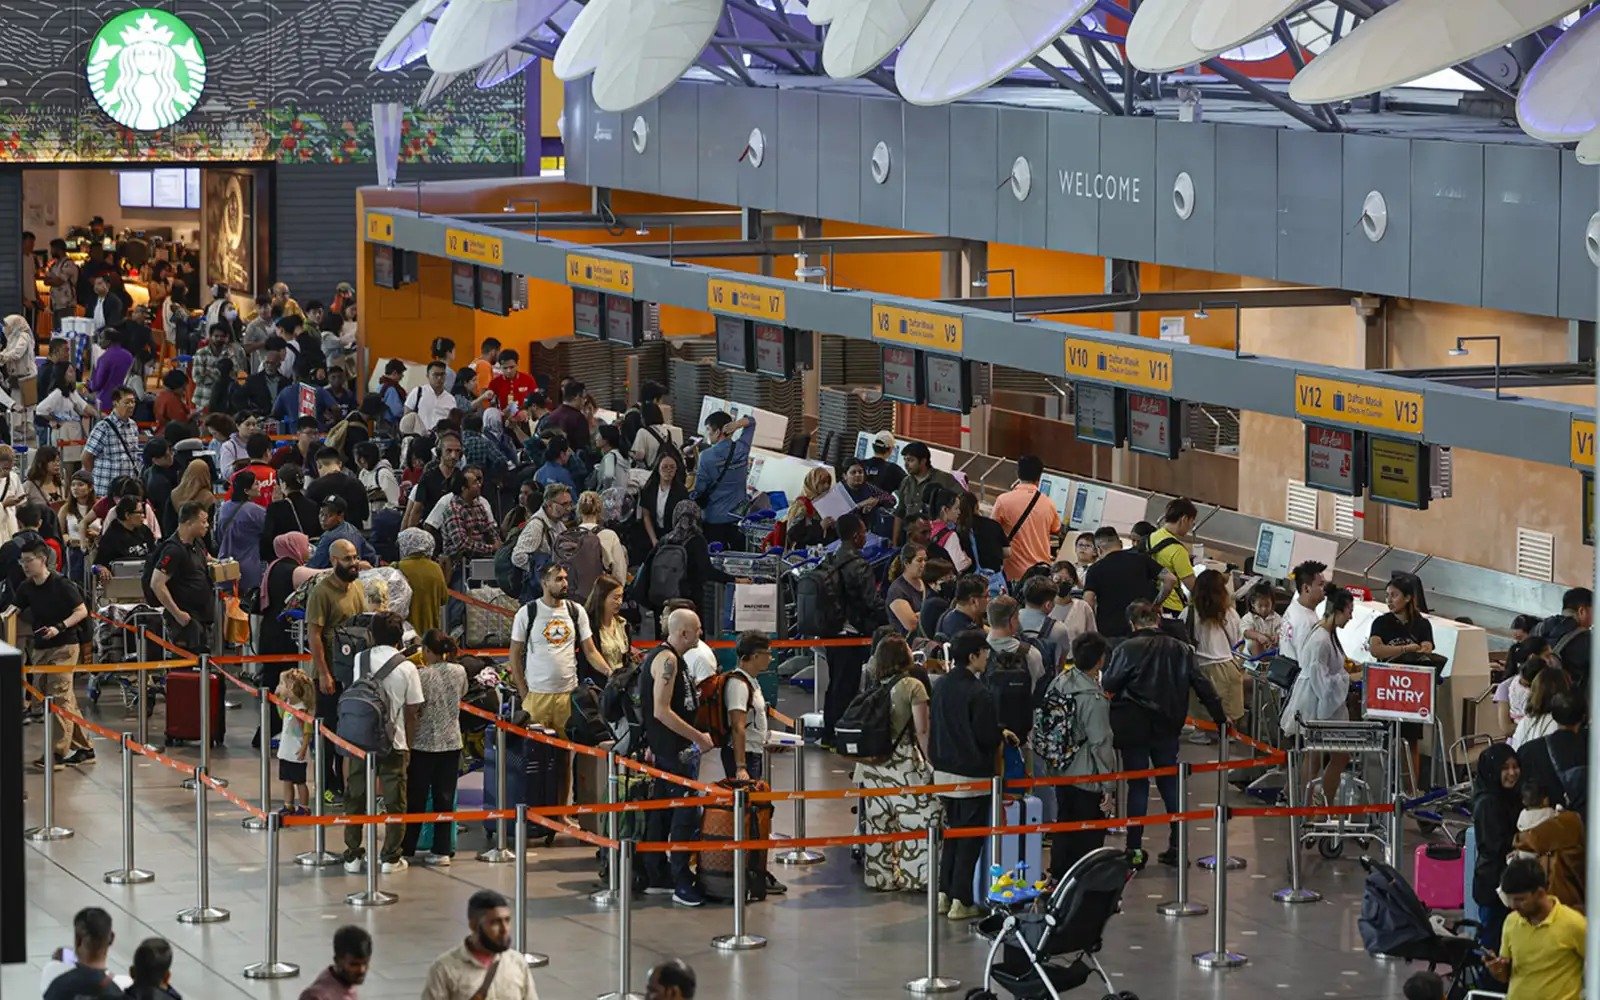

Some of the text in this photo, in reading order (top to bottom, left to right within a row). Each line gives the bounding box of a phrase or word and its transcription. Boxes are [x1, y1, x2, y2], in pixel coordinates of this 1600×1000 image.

[1058, 169, 1140, 202] WELCOME
[448, 235, 457, 250] V2
[491, 243, 500, 260] V3
[570, 259, 579, 276] V4
[619, 268, 630, 286] V5
[712, 285, 723, 304] V6
[769, 295, 780, 313] V7
[877, 312, 889, 331] V8
[944, 323, 957, 343] V9
[1069, 346, 1088, 368] V10
[1149, 359, 1169, 382] V11
[1299, 384, 1322, 408] V12
[1347, 392, 1383, 408] Daftar Masuk
[1394, 400, 1418, 424] V13
[1389, 674, 1412, 688] NO
[1376, 688, 1424, 703] ENTRY
